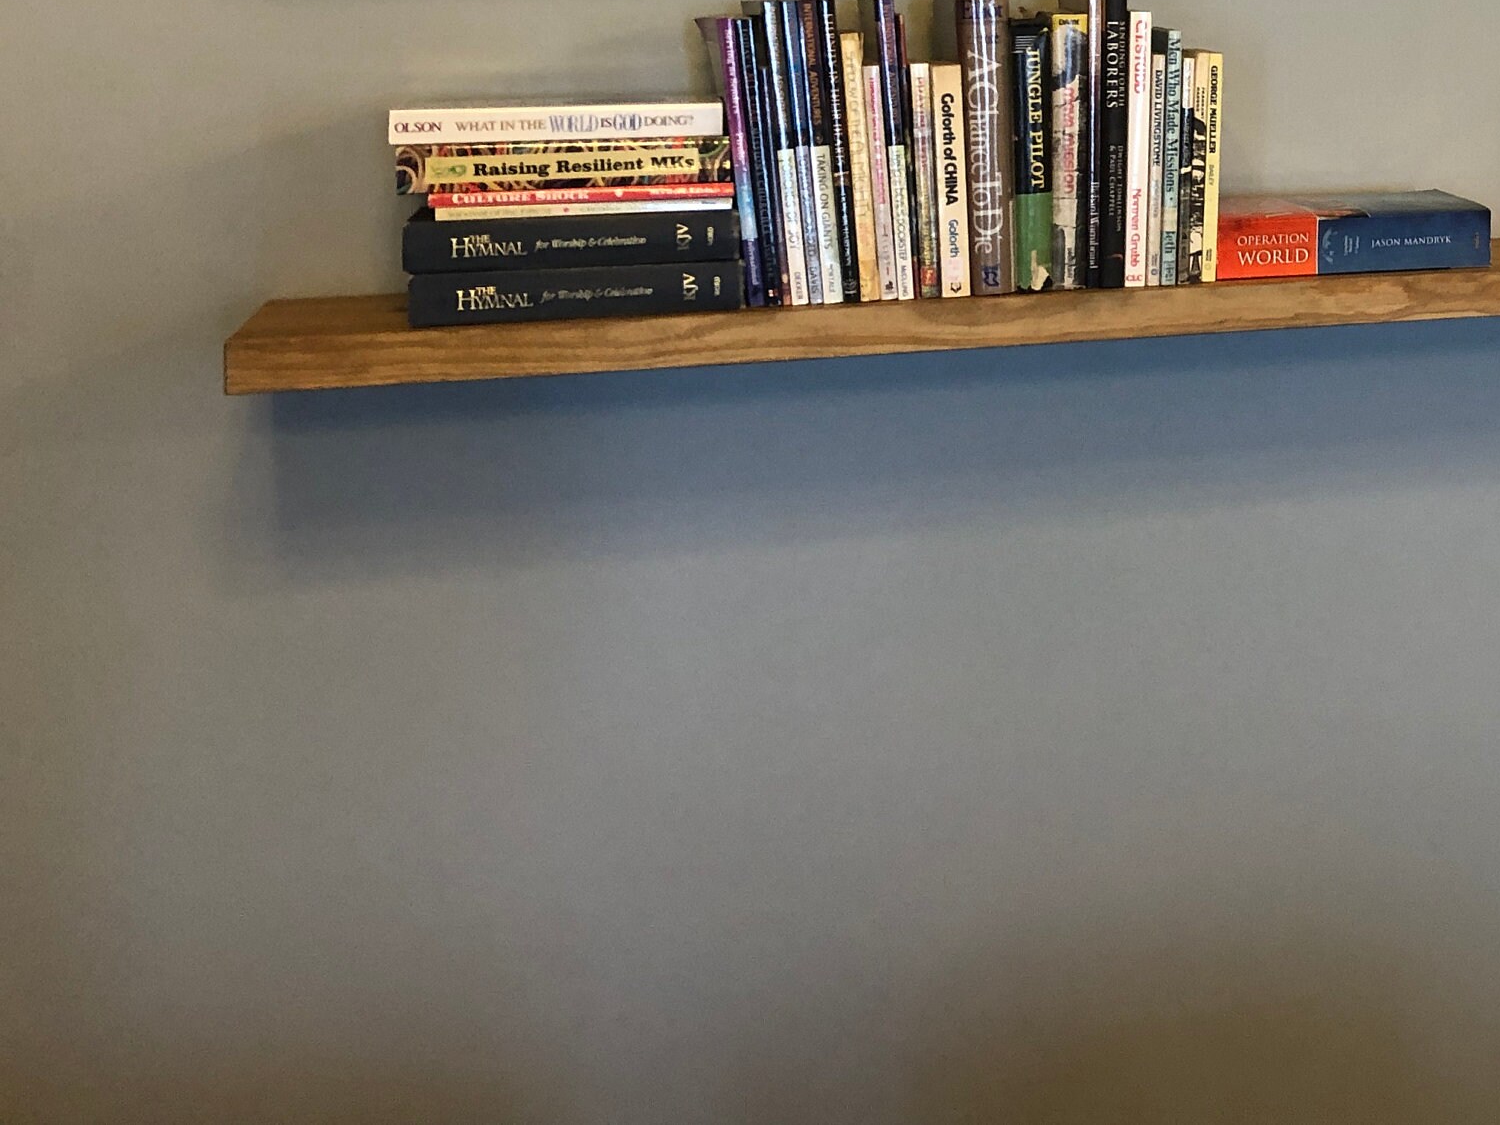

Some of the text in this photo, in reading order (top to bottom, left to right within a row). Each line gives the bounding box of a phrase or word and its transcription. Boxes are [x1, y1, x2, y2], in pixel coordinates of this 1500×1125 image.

[803, 3, 822, 126] INTERNATIONAL ADVENTURES
[1106, 21, 1119, 109] LABORERS
[1118, 21, 1126, 107] SENDING FORTH
[455, 114, 695, 133] WHAT IN THE WORLD IS GOD DOING?
[1026, 47, 1045, 188] JUNGLE PILOT
[1153, 70, 1163, 166] DAVID LIVINGSTONE
[1166, 38, 1181, 193] Men Who Made Missions
[1209, 65, 1219, 154] GEORGE MUELLER
[394, 121, 442, 133] OLSON
[968, 81, 1001, 173] Chance
[941, 93, 958, 206] Goforth of CHINA
[473, 156, 695, 177] Raising Resilient MKs
[452, 190, 590, 204] CULTURE SHOCK
[816, 154, 832, 250] TAKING ON GIANTS
[470, 234, 490, 244] THE
[676, 223, 693, 251] KJV
[948, 219, 960, 258] Goforth
[1130, 188, 1142, 267] Norman Grubb
[1237, 232, 1309, 247] OPERATION
[450, 236, 528, 259] HYMNAL
[1371, 238, 1402, 249] JASON
[1404, 235, 1452, 246] MANDRYK
[1237, 248, 1309, 266] WORLD
[476, 286, 496, 296] THE
[682, 272, 699, 301] KJV
[809, 266, 819, 294] DAVIS
[456, 289, 534, 311] HYMNAL
